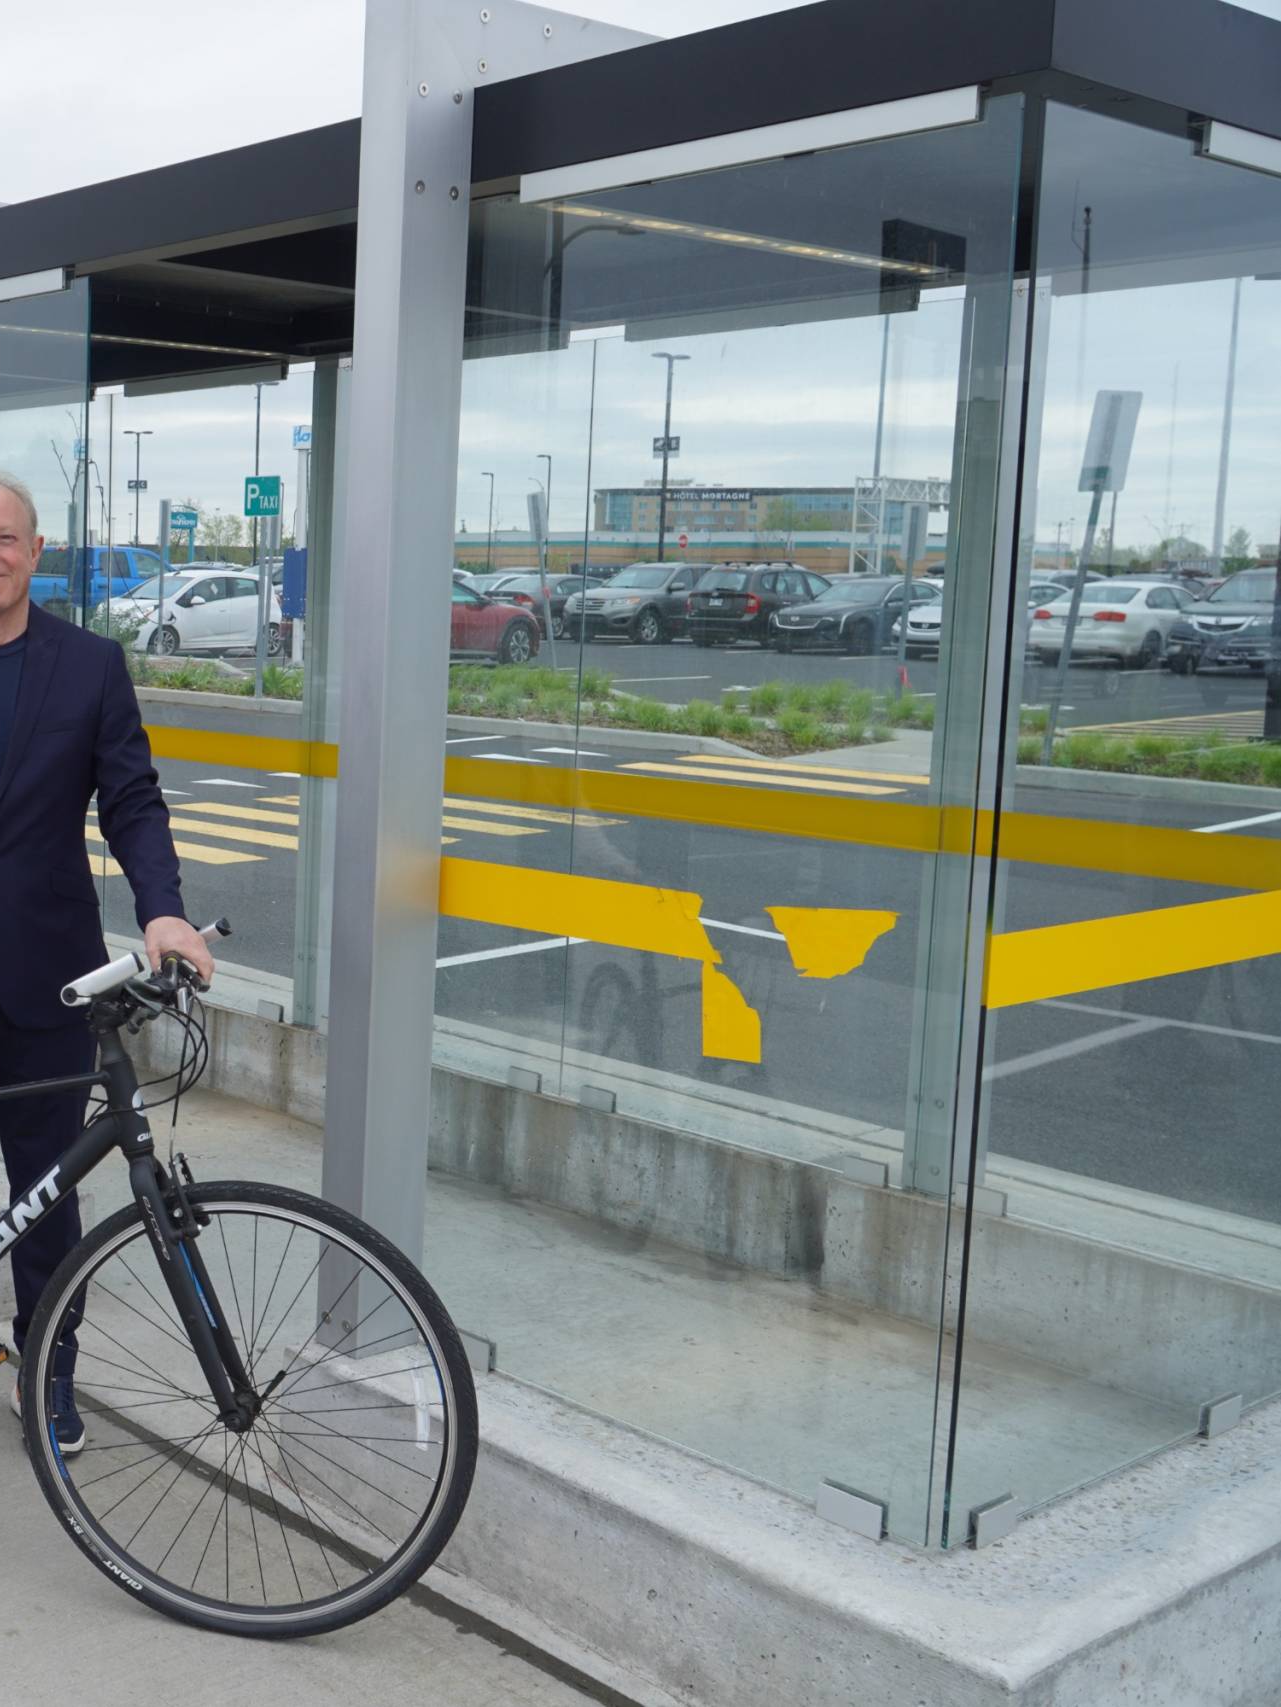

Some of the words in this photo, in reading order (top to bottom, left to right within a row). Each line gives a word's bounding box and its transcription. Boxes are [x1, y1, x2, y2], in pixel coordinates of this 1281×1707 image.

[247, 483, 260, 510] P
[259, 495, 278, 509] TAXI
[673, 490, 699, 500] HÔTEL
[702, 491, 750, 500] MORTAGNE
[102, 1559, 143, 1591] GIANT
